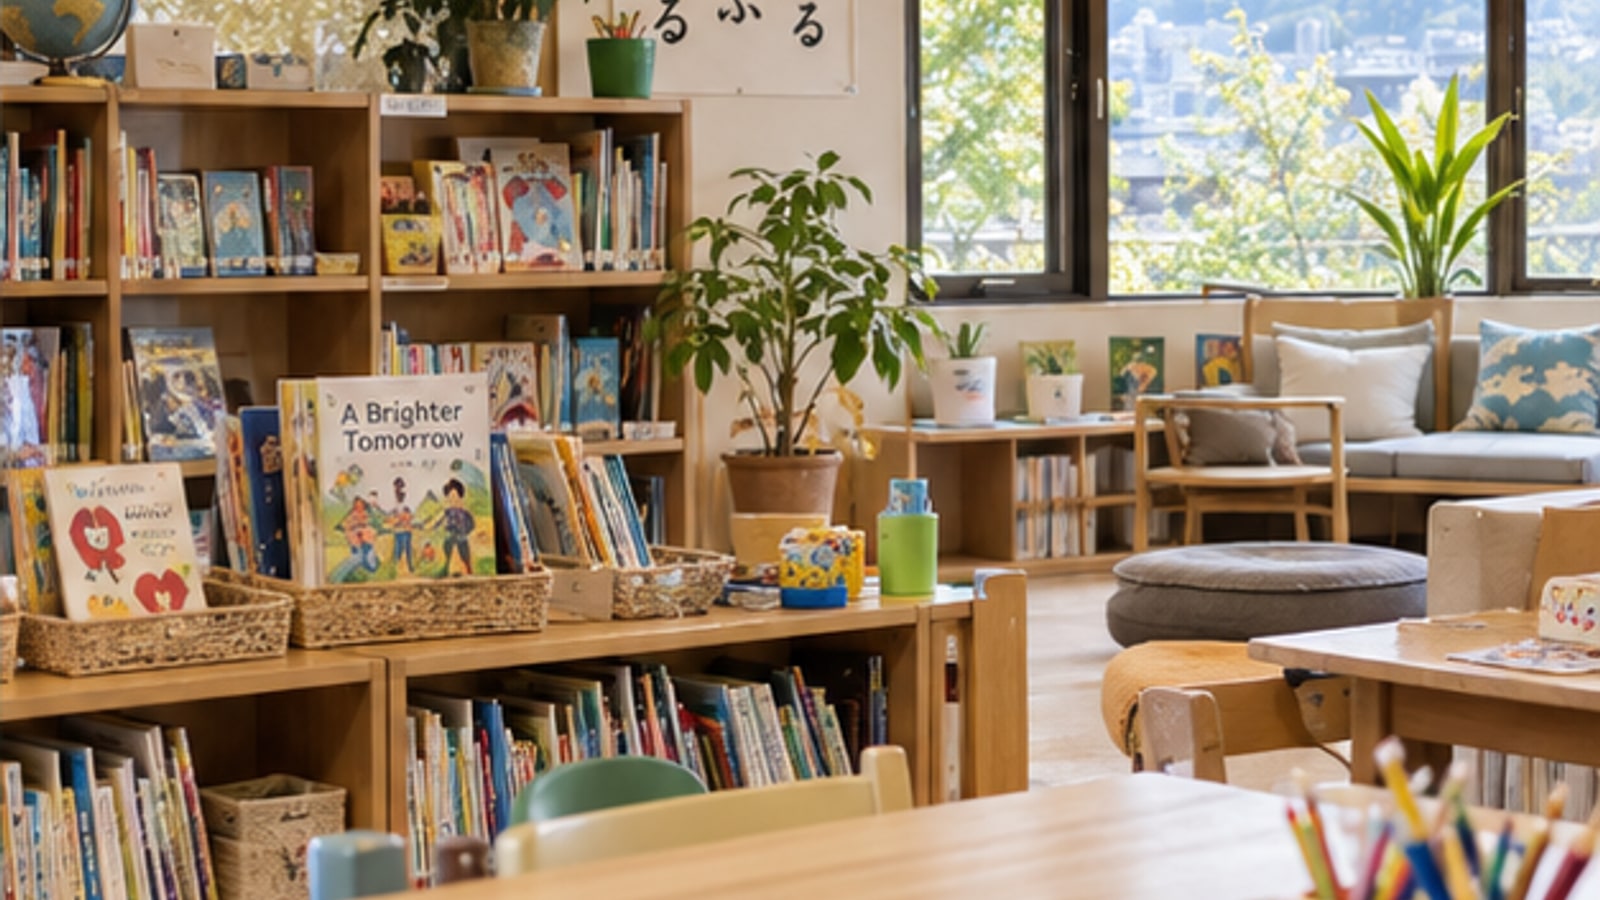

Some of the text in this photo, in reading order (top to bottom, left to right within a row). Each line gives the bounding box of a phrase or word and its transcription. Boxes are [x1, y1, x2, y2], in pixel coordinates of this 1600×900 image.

[341, 400, 463, 429] A Brighter
[343, 429, 464, 452] Tomorrow
